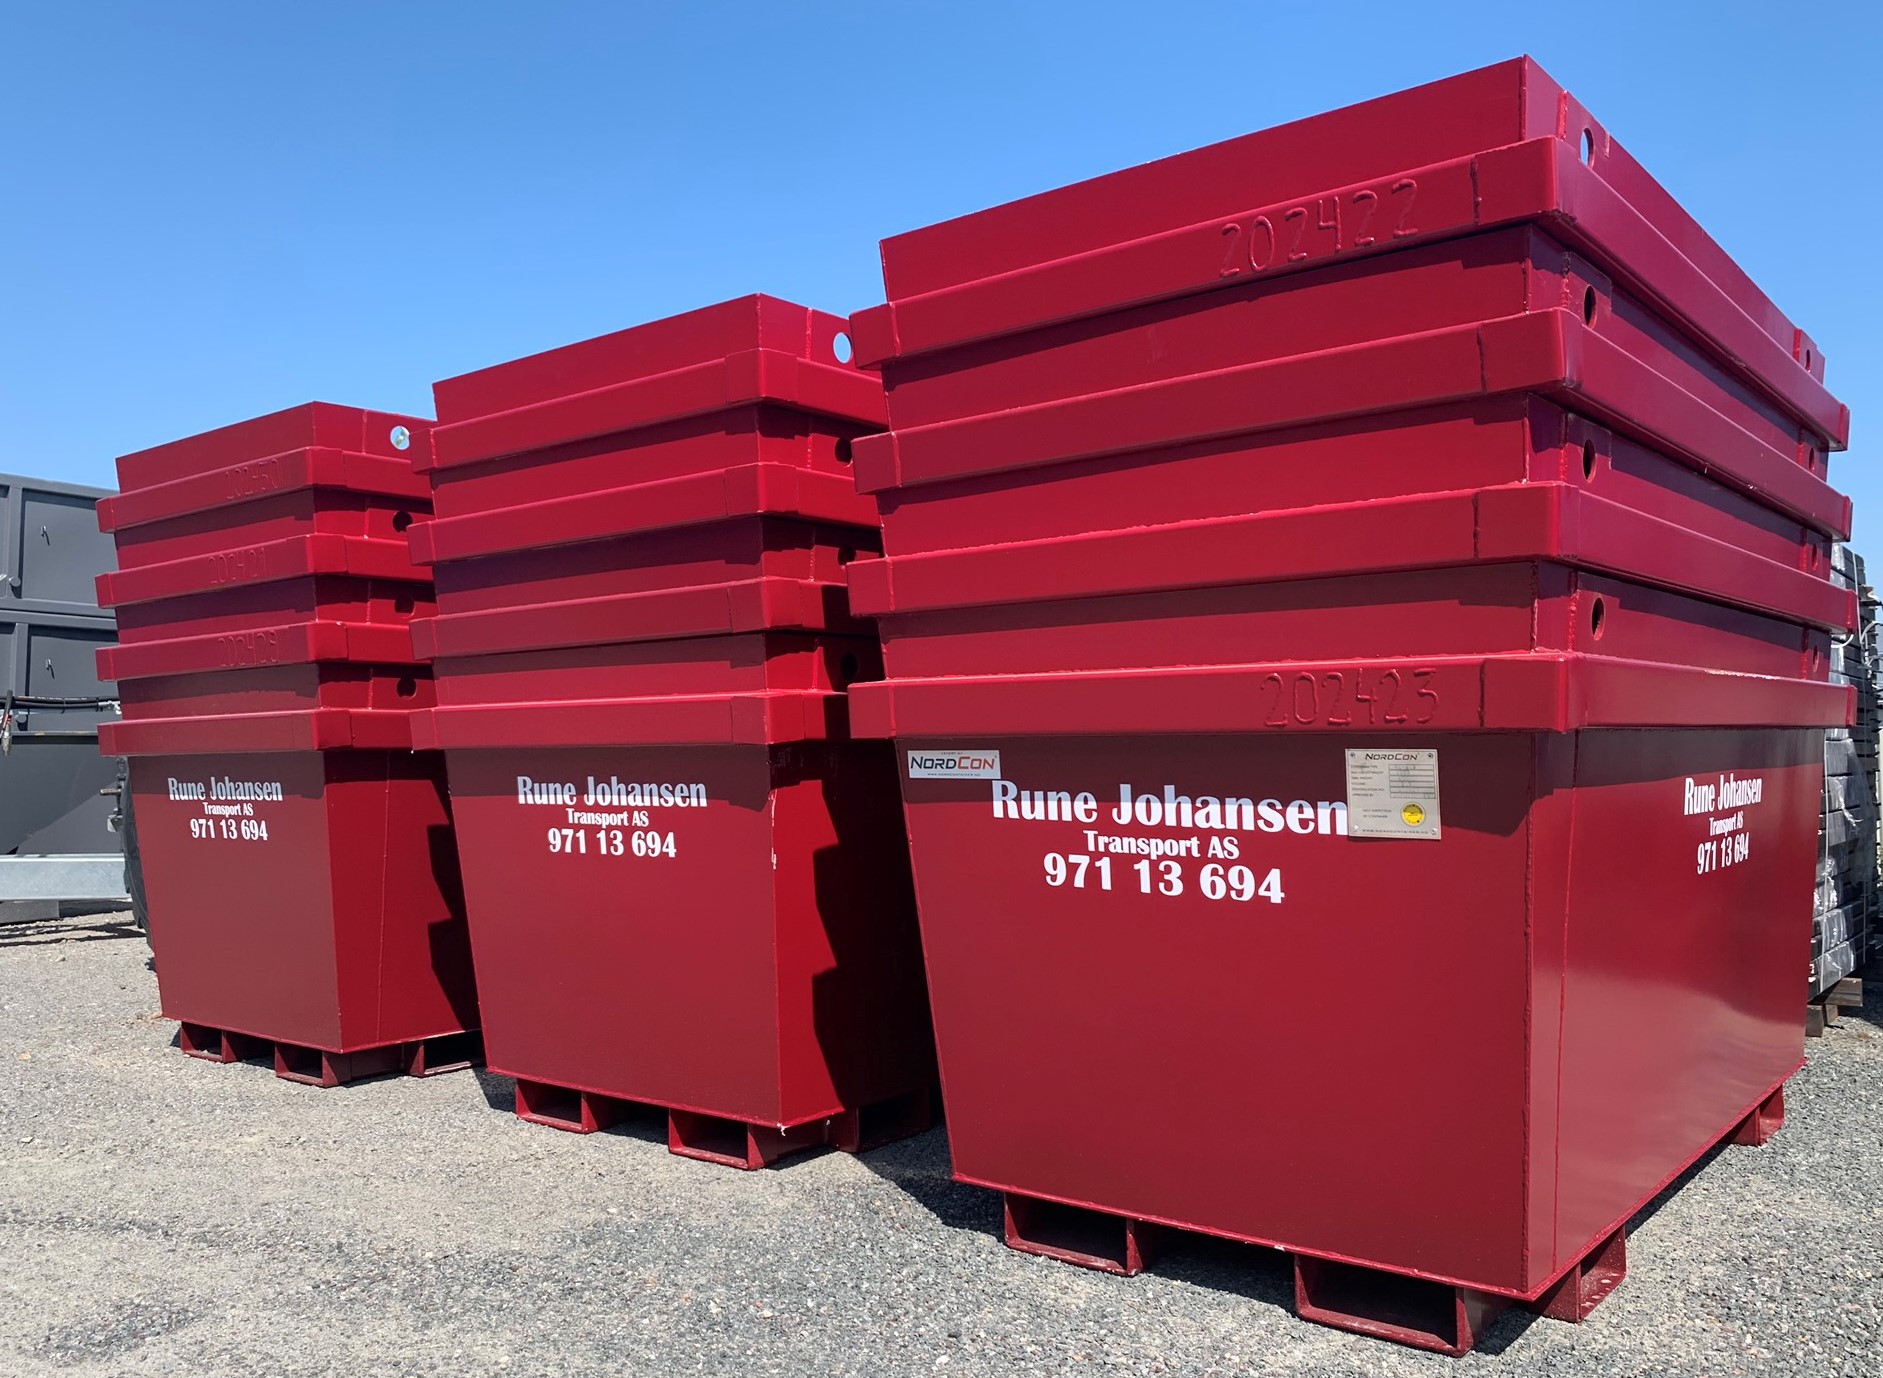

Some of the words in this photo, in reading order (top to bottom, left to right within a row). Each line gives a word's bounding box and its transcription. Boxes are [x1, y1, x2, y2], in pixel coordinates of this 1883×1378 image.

[1219, 178, 1418, 278] 202422
[1260, 667, 1439, 728] 202423
[167, 777, 206, 801] Rune
[210, 776, 283, 802] Johansen
[517, 776, 577, 805] Rune
[583, 776, 708, 807] Johansen
[1684, 777, 1716, 816] Rune
[1717, 773, 1763, 811] Johansen
[203, 802, 241, 818] Transport
[243, 802, 254, 816] AS
[566, 808, 629, 829] Transport
[632, 810, 650, 828] AS
[992, 780, 1098, 823] Rune
[1112, 784, 1347, 836] Johansen
[1709, 812, 1737, 837] Transport
[1736, 810, 1744, 829] AS
[190, 818, 216, 839] 971
[219, 818, 238, 839] 13
[241, 819, 268, 841] 694
[548, 828, 587, 854] 971
[596, 829, 625, 856] 13
[631, 831, 677, 858] 694
[1083, 830, 1201, 861] Transport
[1207, 836, 1240, 860] AS
[1697, 840, 1717, 875] 971
[1720, 836, 1733, 868] 13
[1734, 831, 1750, 864] 694
[1043, 852, 1112, 891] 971
[1133, 859, 1184, 897] 13
[1200, 863, 1285, 904] 694
